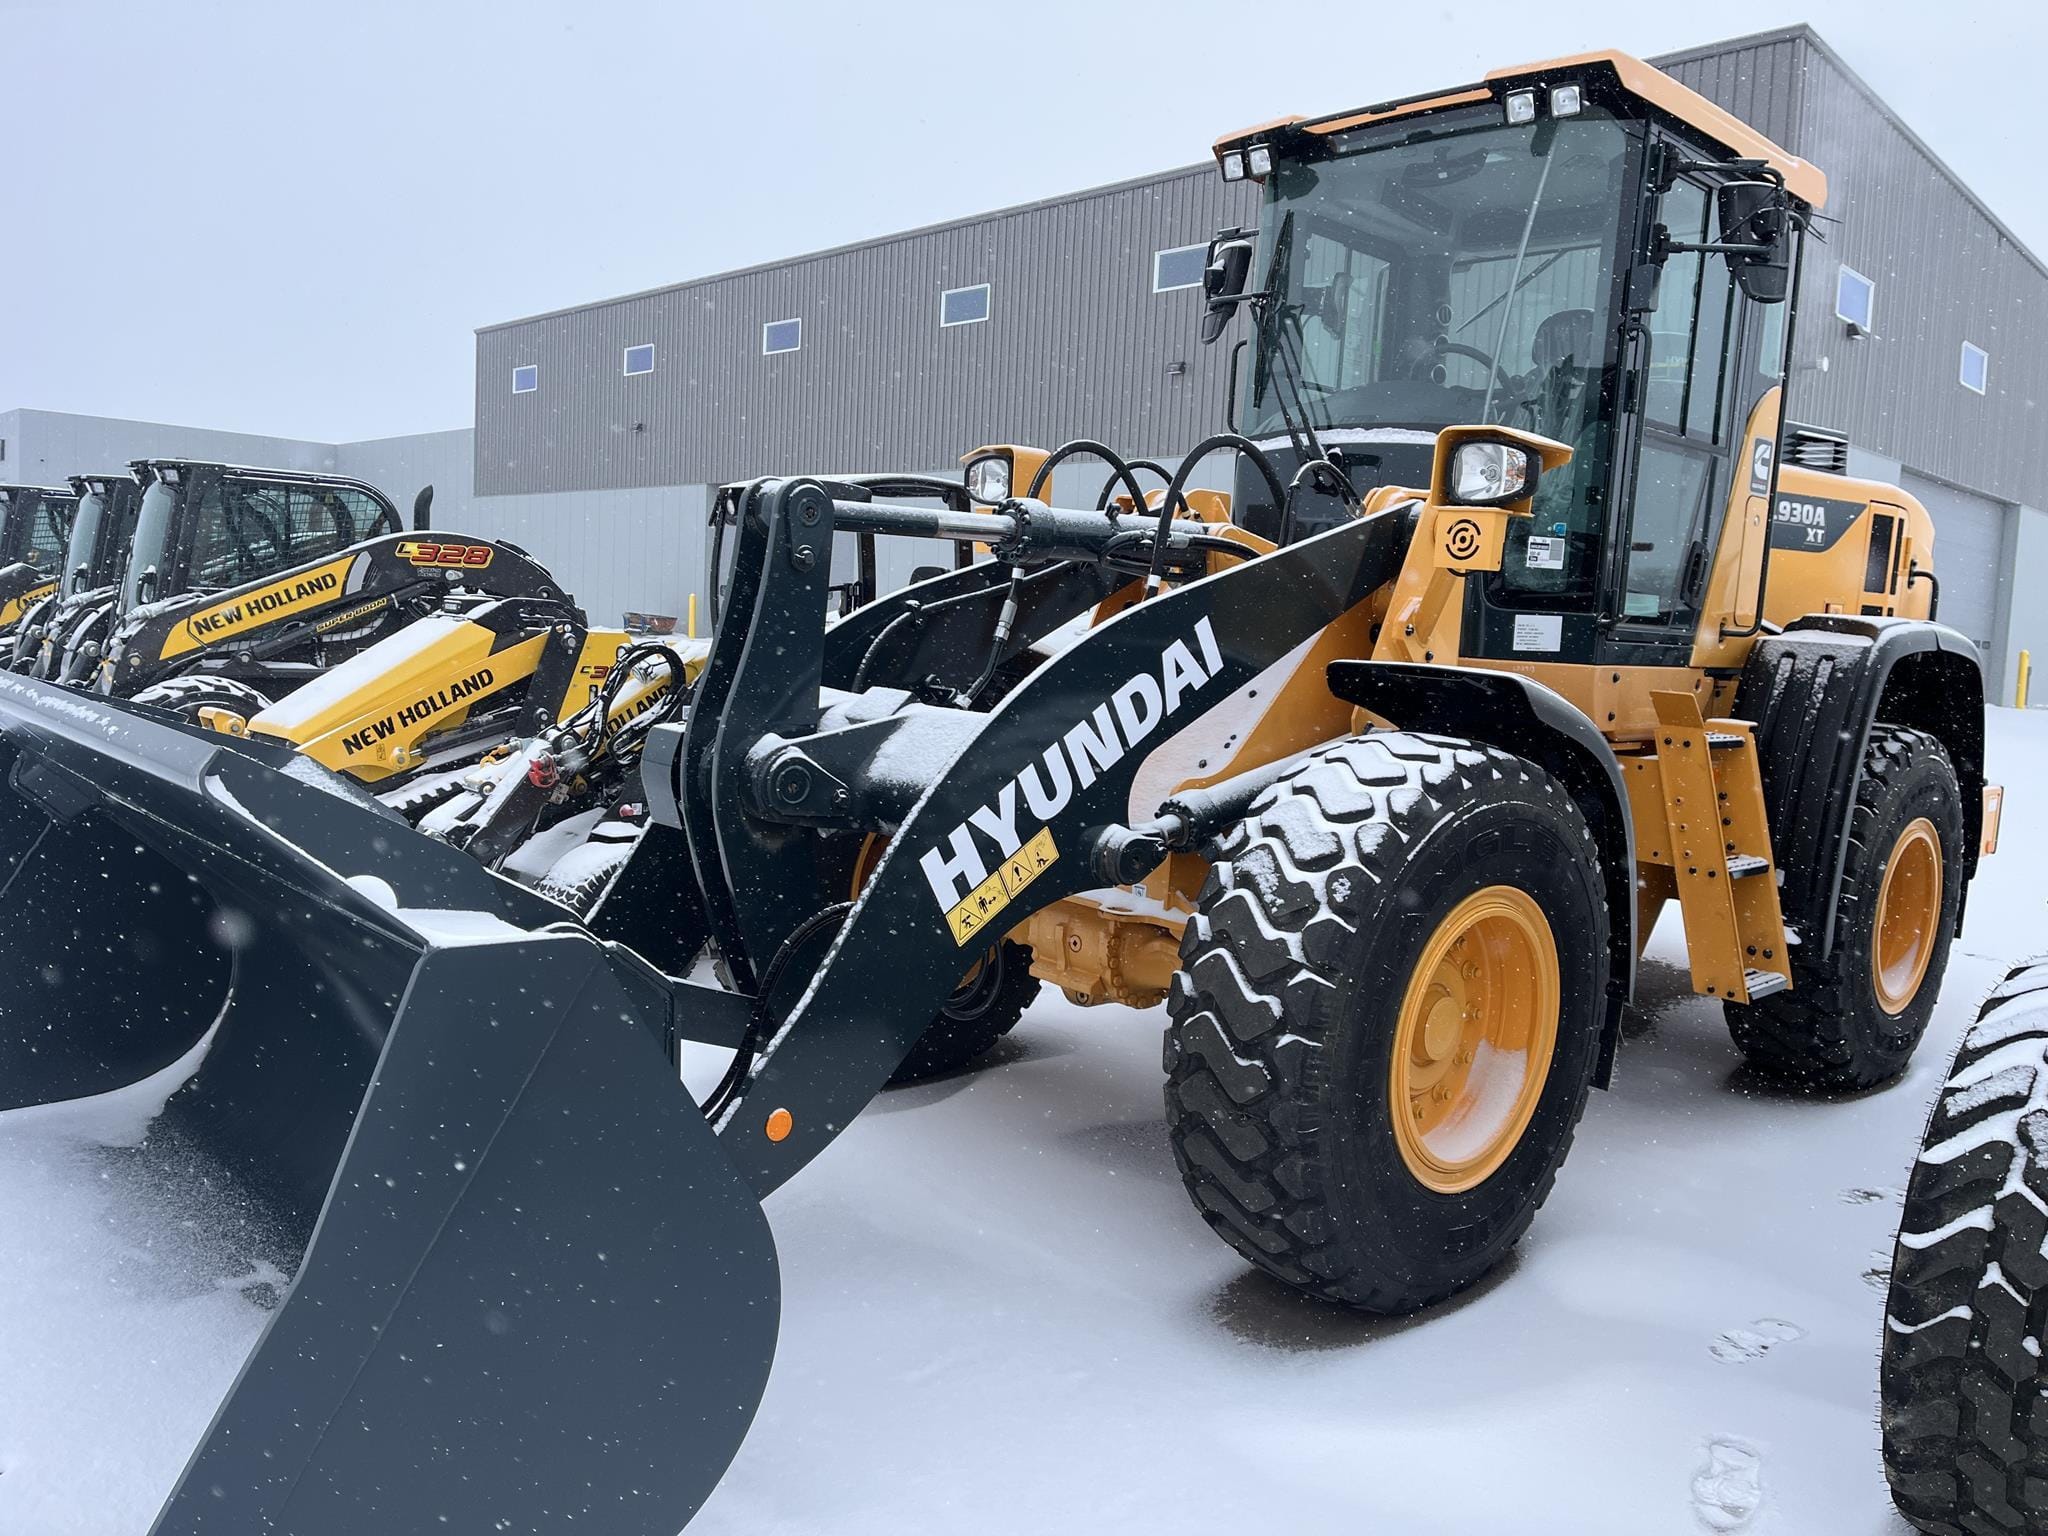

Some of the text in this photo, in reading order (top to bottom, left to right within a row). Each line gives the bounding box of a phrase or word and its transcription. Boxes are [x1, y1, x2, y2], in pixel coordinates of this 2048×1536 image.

[1773, 500, 1826, 527] 930A
[1805, 527, 1825, 543] XT
[396, 542, 493, 567] L328
[193, 573, 337, 635] NEW HOLLAND
[342, 668, 494, 756] NEW HOLLAND
[604, 684, 671, 738] OLLAND
[919, 615, 1224, 914] HYUNDAI
